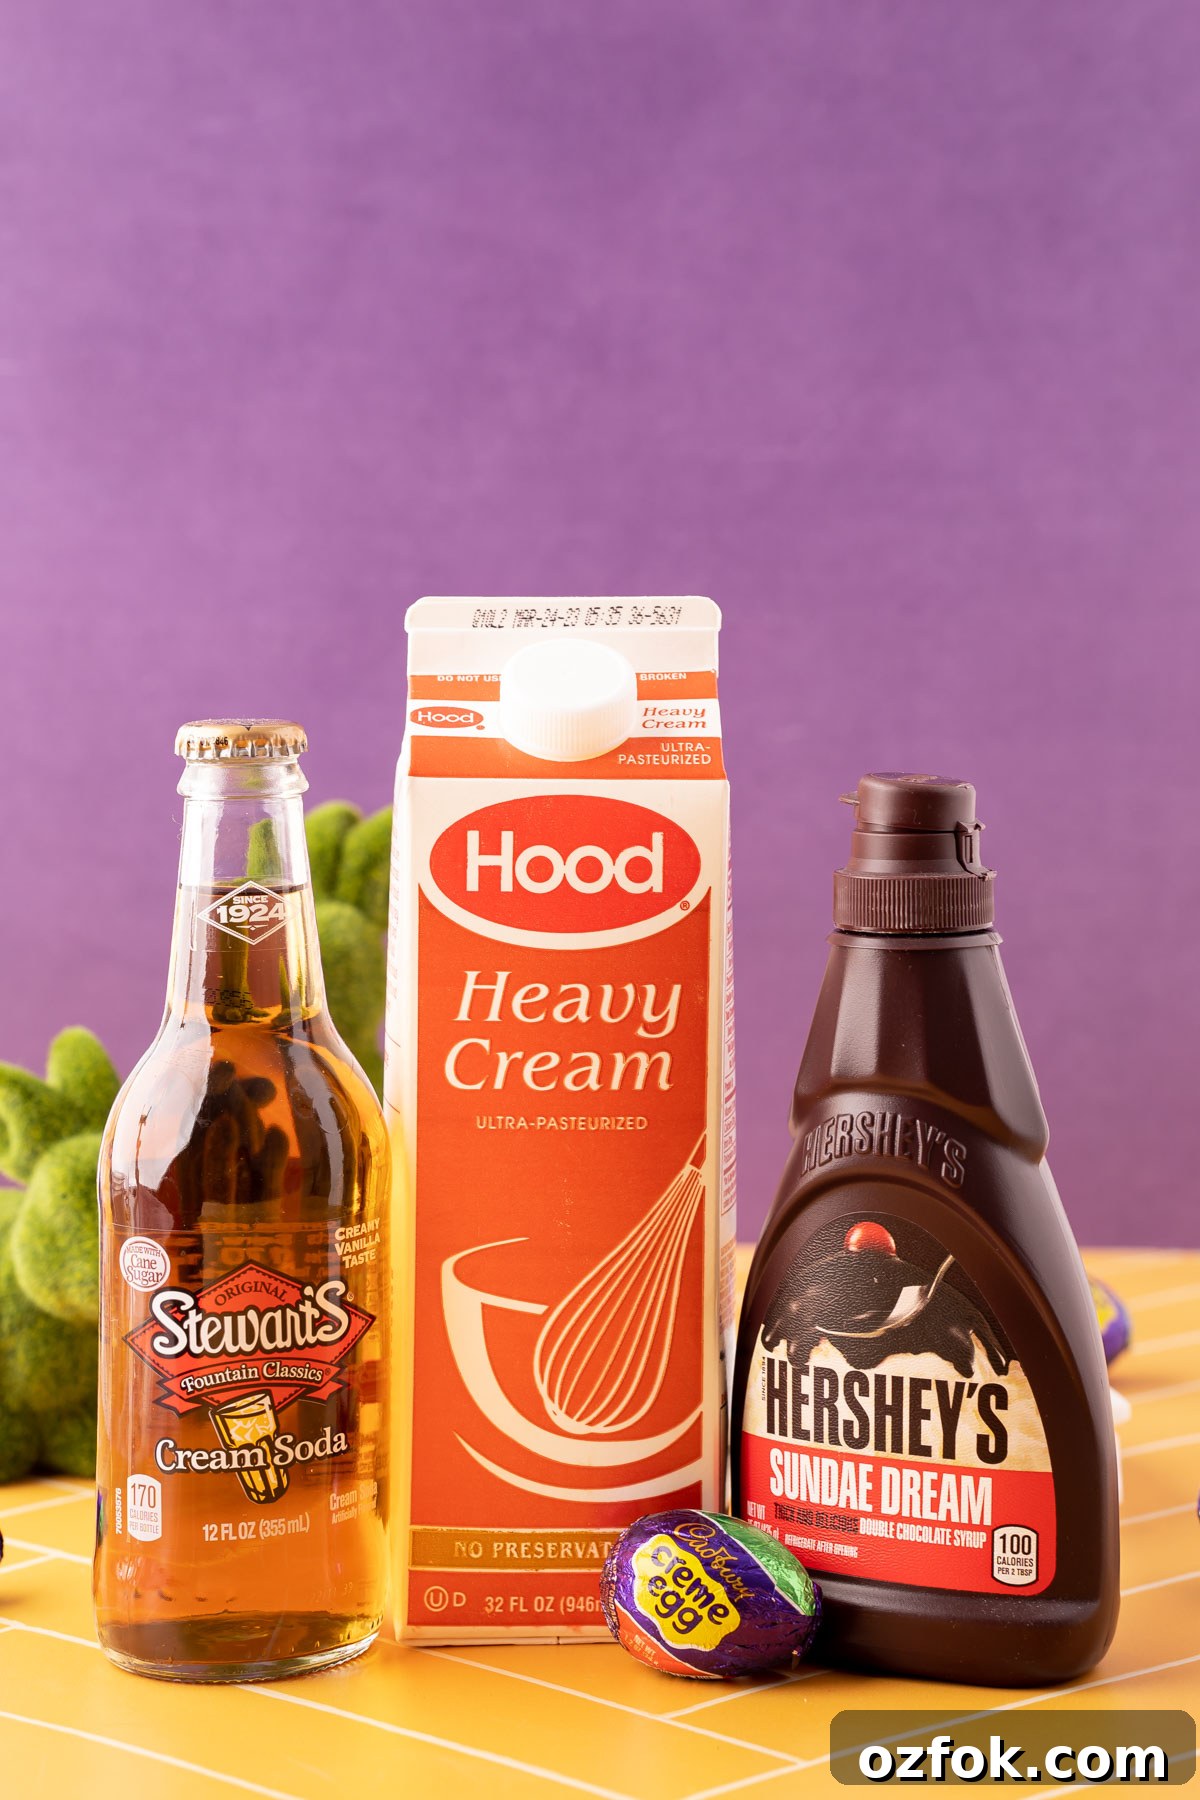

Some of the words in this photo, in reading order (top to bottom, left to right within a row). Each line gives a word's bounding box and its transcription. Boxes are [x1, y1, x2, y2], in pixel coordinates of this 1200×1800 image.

[640, 672, 687, 681] BROKEN
[417, 711, 474, 724] Hood
[643, 707, 706, 718] Heavy
[642, 719, 706, 729] Cream
[661, 742, 711, 752] ULTRA-
[618, 754, 712, 765] PASTEURIZED
[466, 830, 664, 894] Hood
[232, 895, 268, 905] SINCE
[217, 903, 286, 924] 1924
[453, 970, 682, 1039] Heavy
[444, 1038, 674, 1091] Cream
[476, 1115, 648, 1131] ULTRA-PASTEURIZED
[801, 1110, 967, 1188] HERSHEY'S
[334, 1217, 380, 1240] CREAMY
[143, 1247, 161, 1257] WITH
[334, 1232, 381, 1256] VANILLA
[131, 1254, 157, 1270] Cane
[342, 1249, 376, 1269] TASTE
[127, 1265, 162, 1286] Sugar
[214, 1281, 288, 1306] ORIGINAL
[181, 1364, 259, 1393] Fountain
[262, 1361, 323, 1382] Classics
[766, 1357, 1009, 1465] HERSHEY'S
[155, 1438, 266, 1472] Cream
[273, 1426, 348, 1467] Soda
[131, 1482, 156, 1509] 170
[769, 1447, 873, 1512] SUNDAE
[881, 1466, 993, 1526] DREAM
[329, 1490, 358, 1511] Cream
[129, 1509, 159, 1523] CALORIES
[202, 1523, 218, 1542] 12
[220, 1523, 237, 1541] FL
[238, 1521, 257, 1540] OZ
[258, 1518, 286, 1540] (355
[287, 1511, 311, 1534] mL)
[859, 1517, 895, 1539] DOUBLE
[896, 1522, 952, 1546] CHOCOLATE
[953, 1529, 987, 1549] SYRUP
[454, 1541, 483, 1559] NO
[999, 1533, 1032, 1556] 100
[674, 1522, 757, 1602] Cadbury
[996, 1556, 1034, 1568] CALORIES
[998, 1567, 1010, 1575] PER
[1011, 1568, 1016, 1576] 2
[1017, 1568, 1033, 1577] TBSP
[651, 1545, 730, 1626] creme
[453, 1591, 467, 1607] D
[485, 1596, 504, 1614] 32
[509, 1596, 528, 1613] FL
[533, 1596, 554, 1613] OZ
[647, 1575, 704, 1635] egg
